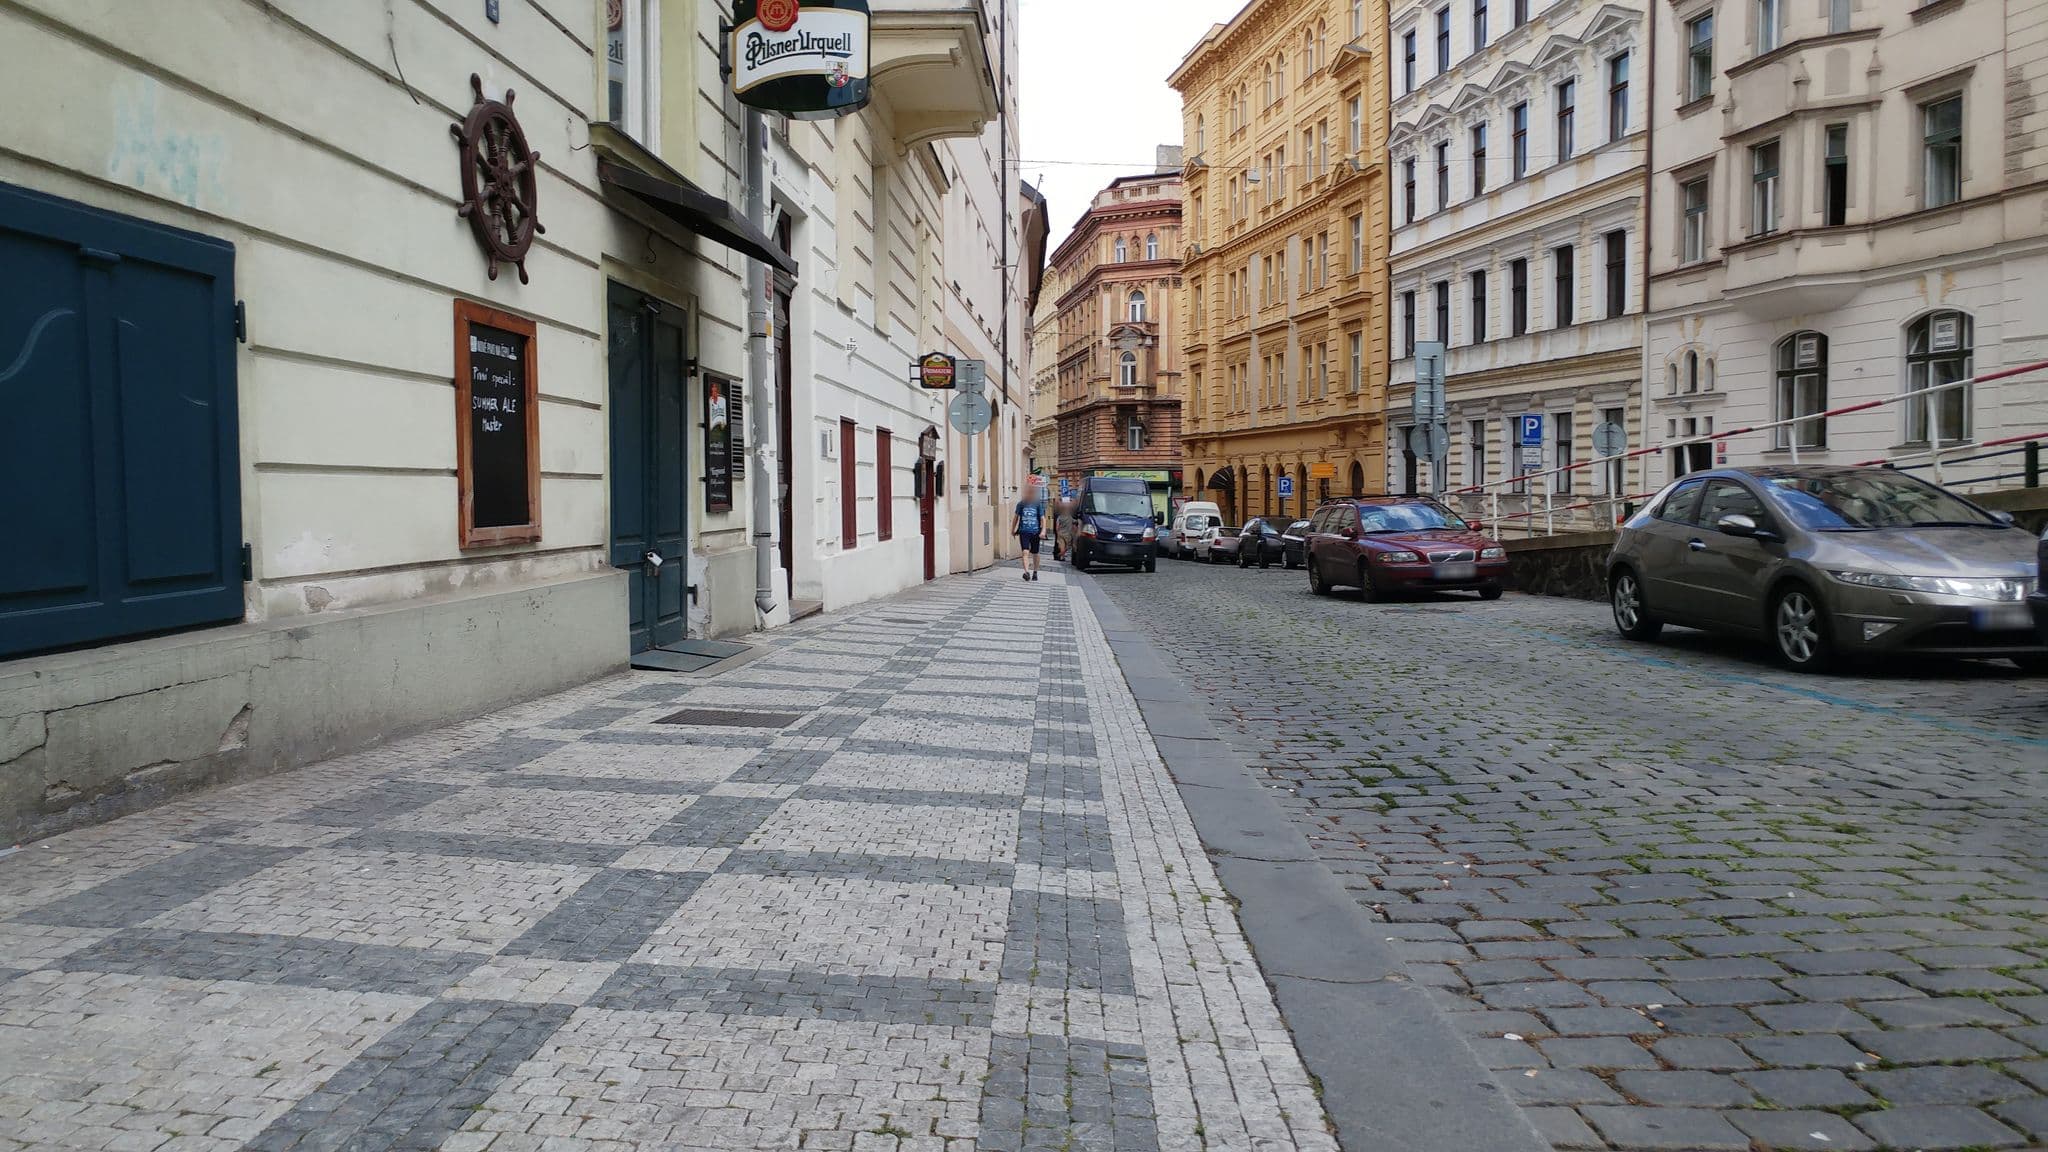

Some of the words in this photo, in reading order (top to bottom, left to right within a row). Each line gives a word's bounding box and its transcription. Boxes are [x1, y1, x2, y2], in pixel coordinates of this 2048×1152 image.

[746, 32, 799, 70] Pilsner
[798, 29, 851, 58] Urquell
[472, 396, 499, 411] SUMMER
[502, 397, 517, 413] ALE
[1525, 418, 1539, 436] P
[1281, 479, 1290, 491] P
